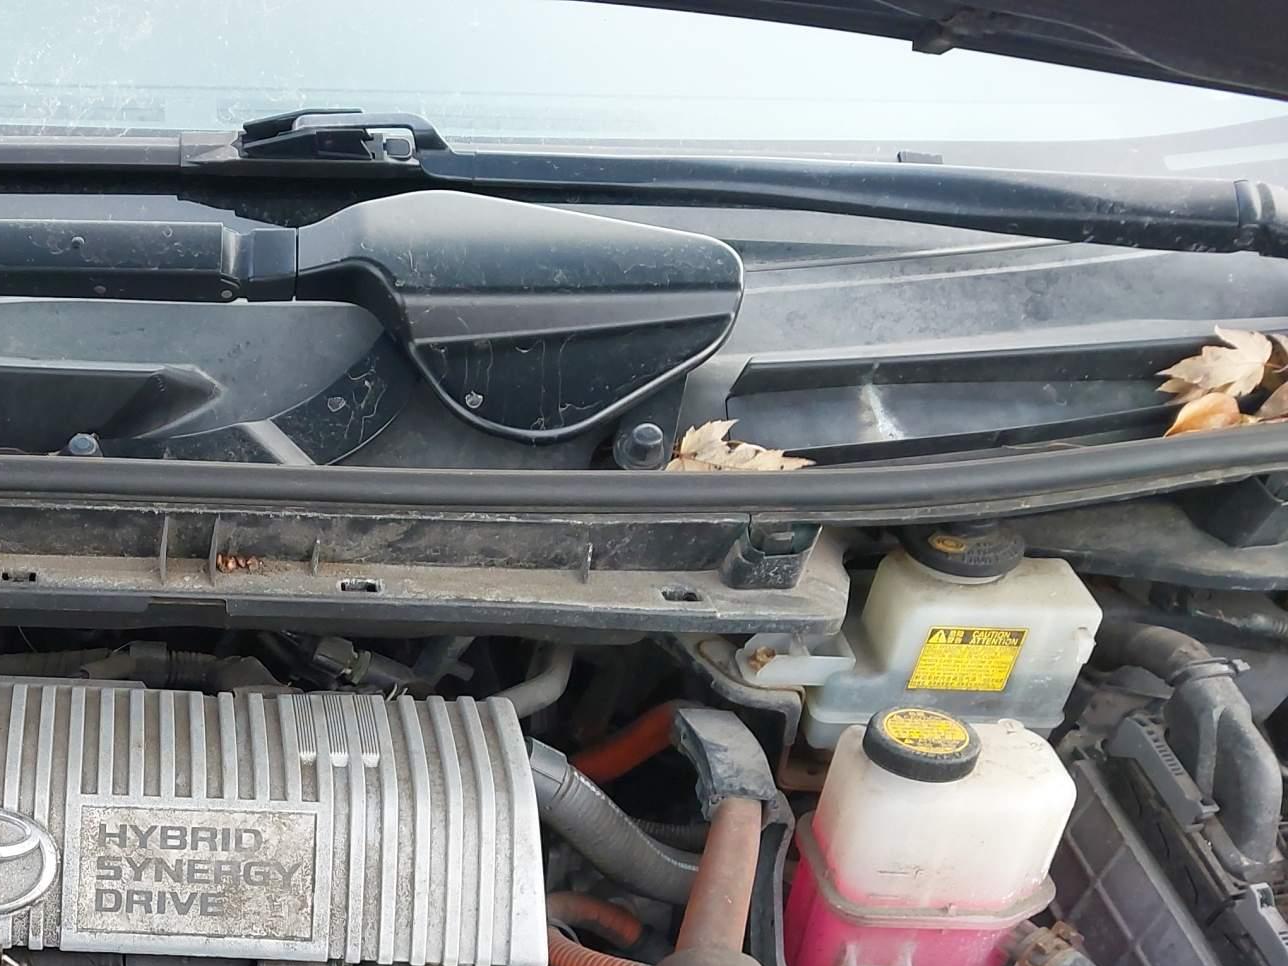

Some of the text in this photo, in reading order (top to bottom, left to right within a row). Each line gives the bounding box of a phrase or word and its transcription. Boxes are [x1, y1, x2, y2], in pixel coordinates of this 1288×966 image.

[969, 637, 1019, 646] ATTENTION
[972, 630, 1010, 639] CAUTION
[98, 823, 262, 852] HYBRID
[95, 855, 302, 889] SYNERGY
[94, 888, 225, 917] DRIVE
